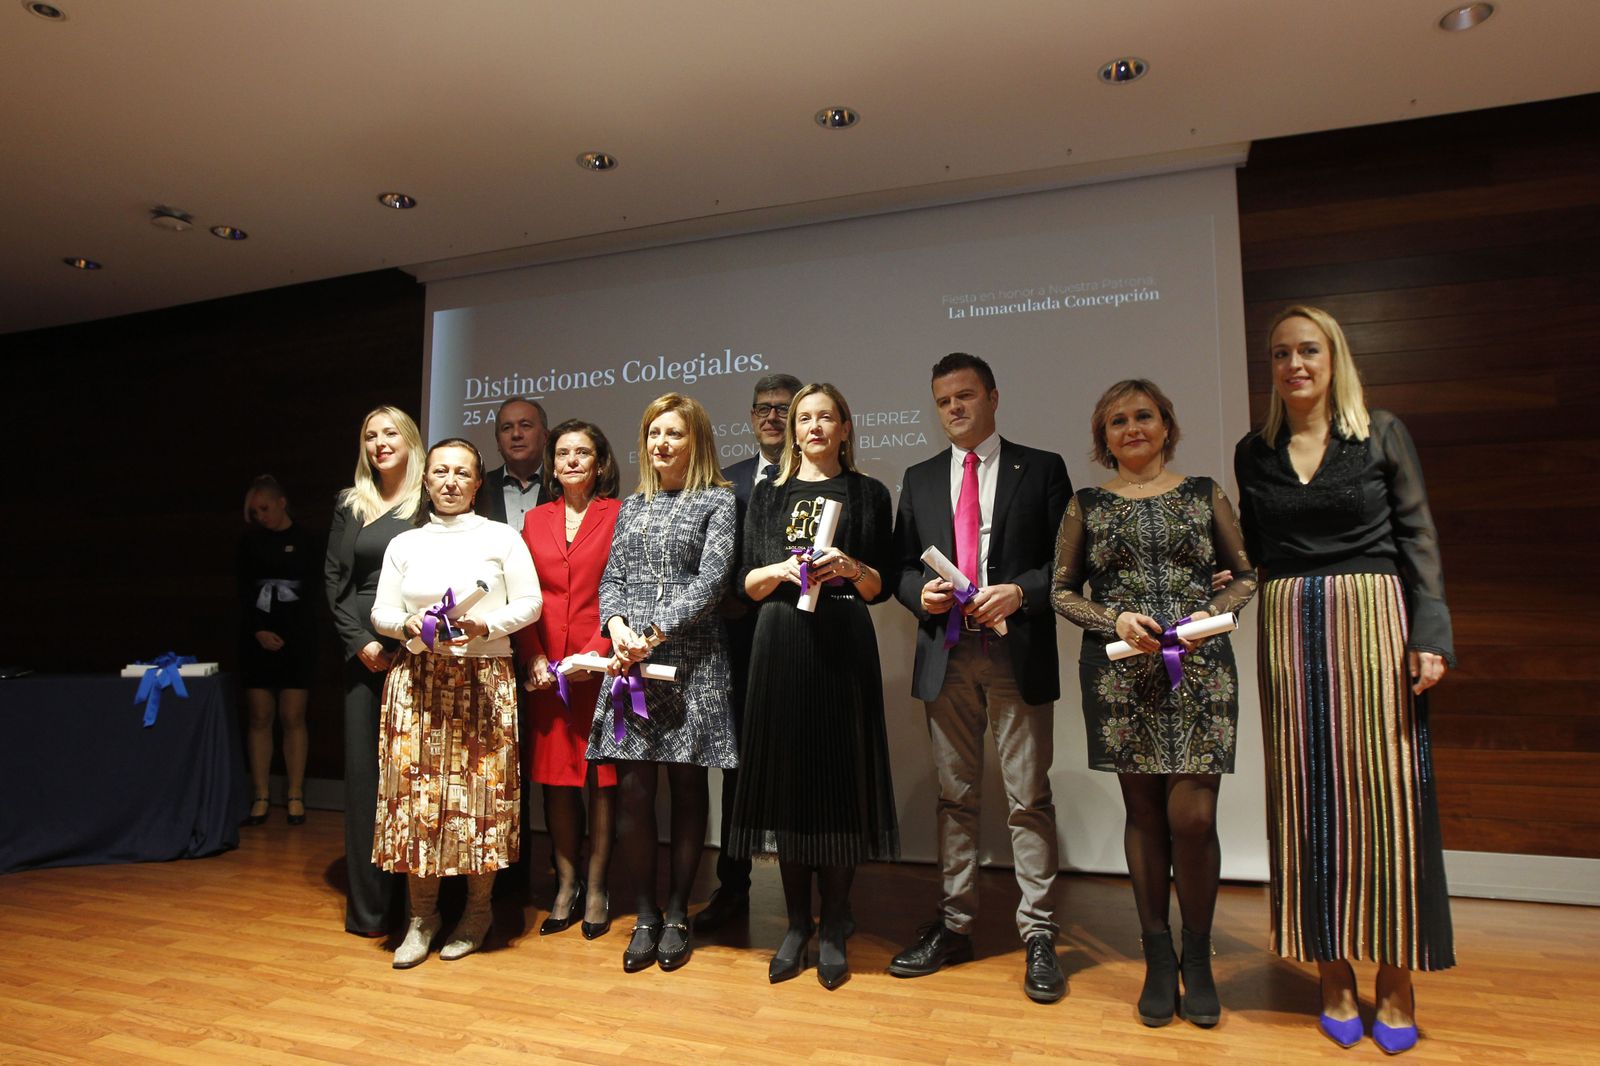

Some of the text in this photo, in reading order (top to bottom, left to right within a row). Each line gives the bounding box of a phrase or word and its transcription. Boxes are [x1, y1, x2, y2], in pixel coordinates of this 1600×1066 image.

[942, 293, 977, 306] Fiesta
[979, 292, 995, 303] en
[998, 288, 1034, 300] honor
[1049, 281, 1099, 295] Nuestra
[948, 287, 1160, 319] La Inmaculada Concepción
[464, 349, 769, 400] Distinciones Colegiales.
[462, 409, 482, 426] 25
[852, 410, 920, 427] TIERREZ
[860, 432, 928, 449] BLANCA
